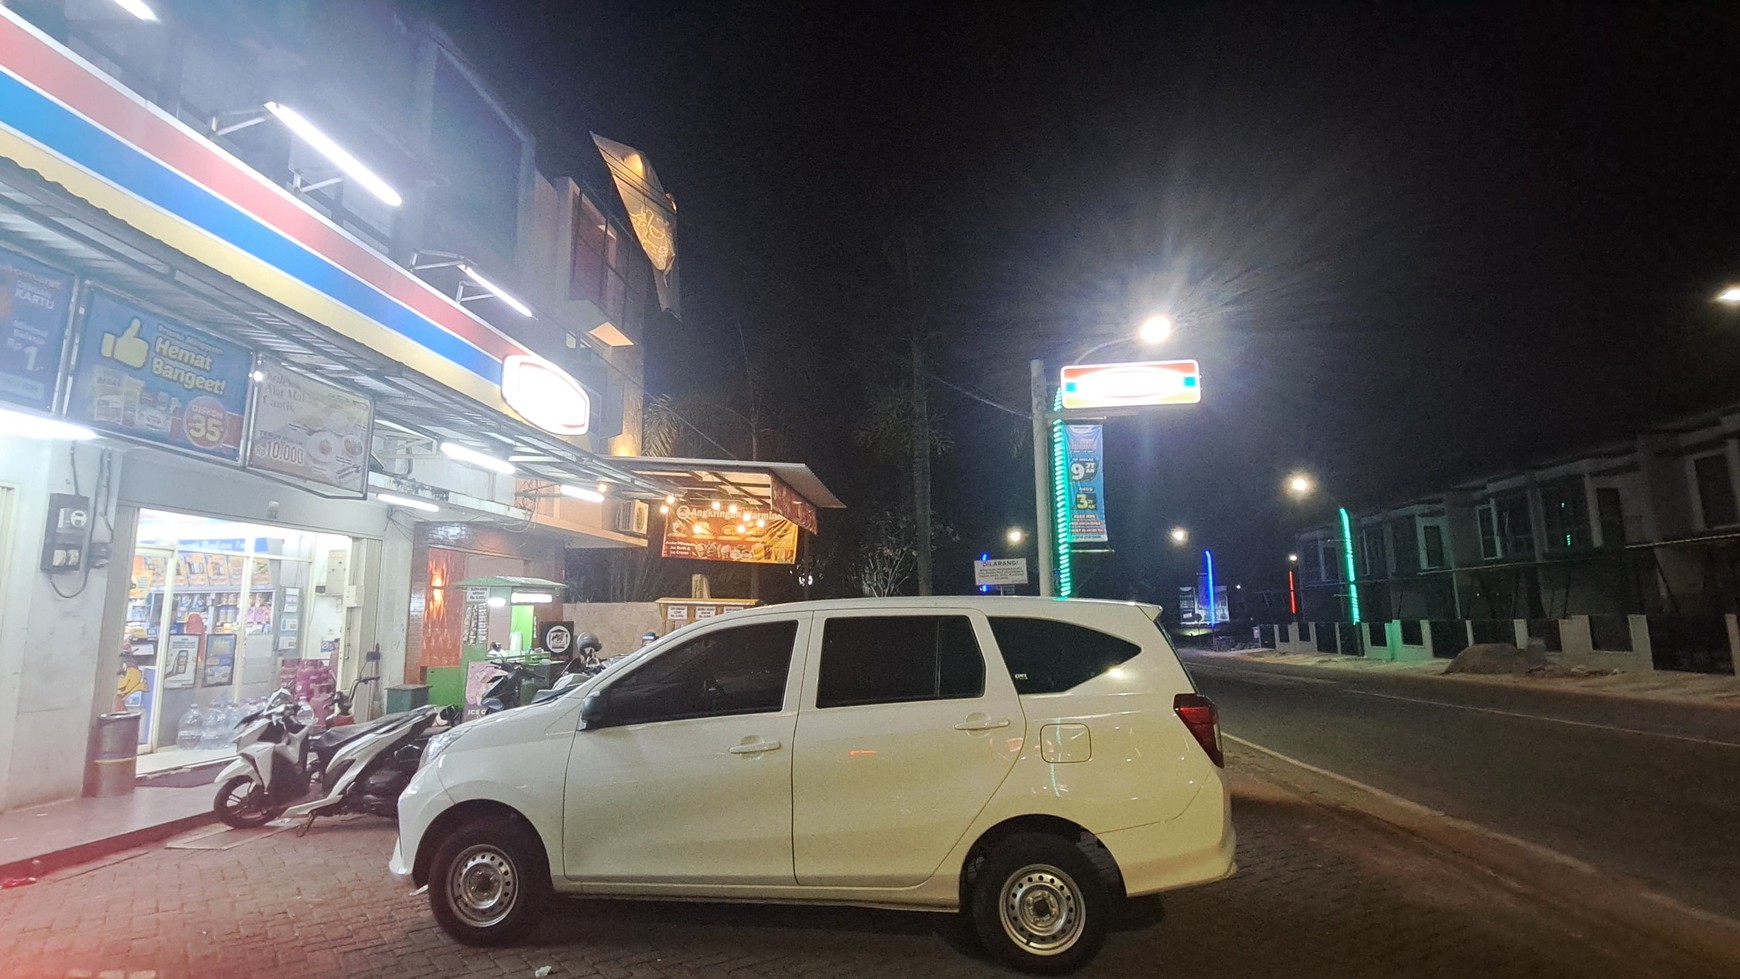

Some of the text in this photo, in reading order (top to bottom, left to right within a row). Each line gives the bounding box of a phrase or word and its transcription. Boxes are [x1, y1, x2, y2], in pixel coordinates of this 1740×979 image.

[155, 336, 213, 371] Hemat
[152, 357, 226, 396] Bangeet!
[188, 412, 223, 442] 35
[1070, 463, 1085, 480] 9
[1076, 494, 1088, 509] 3
[691, 508, 741, 520] Angkringan
